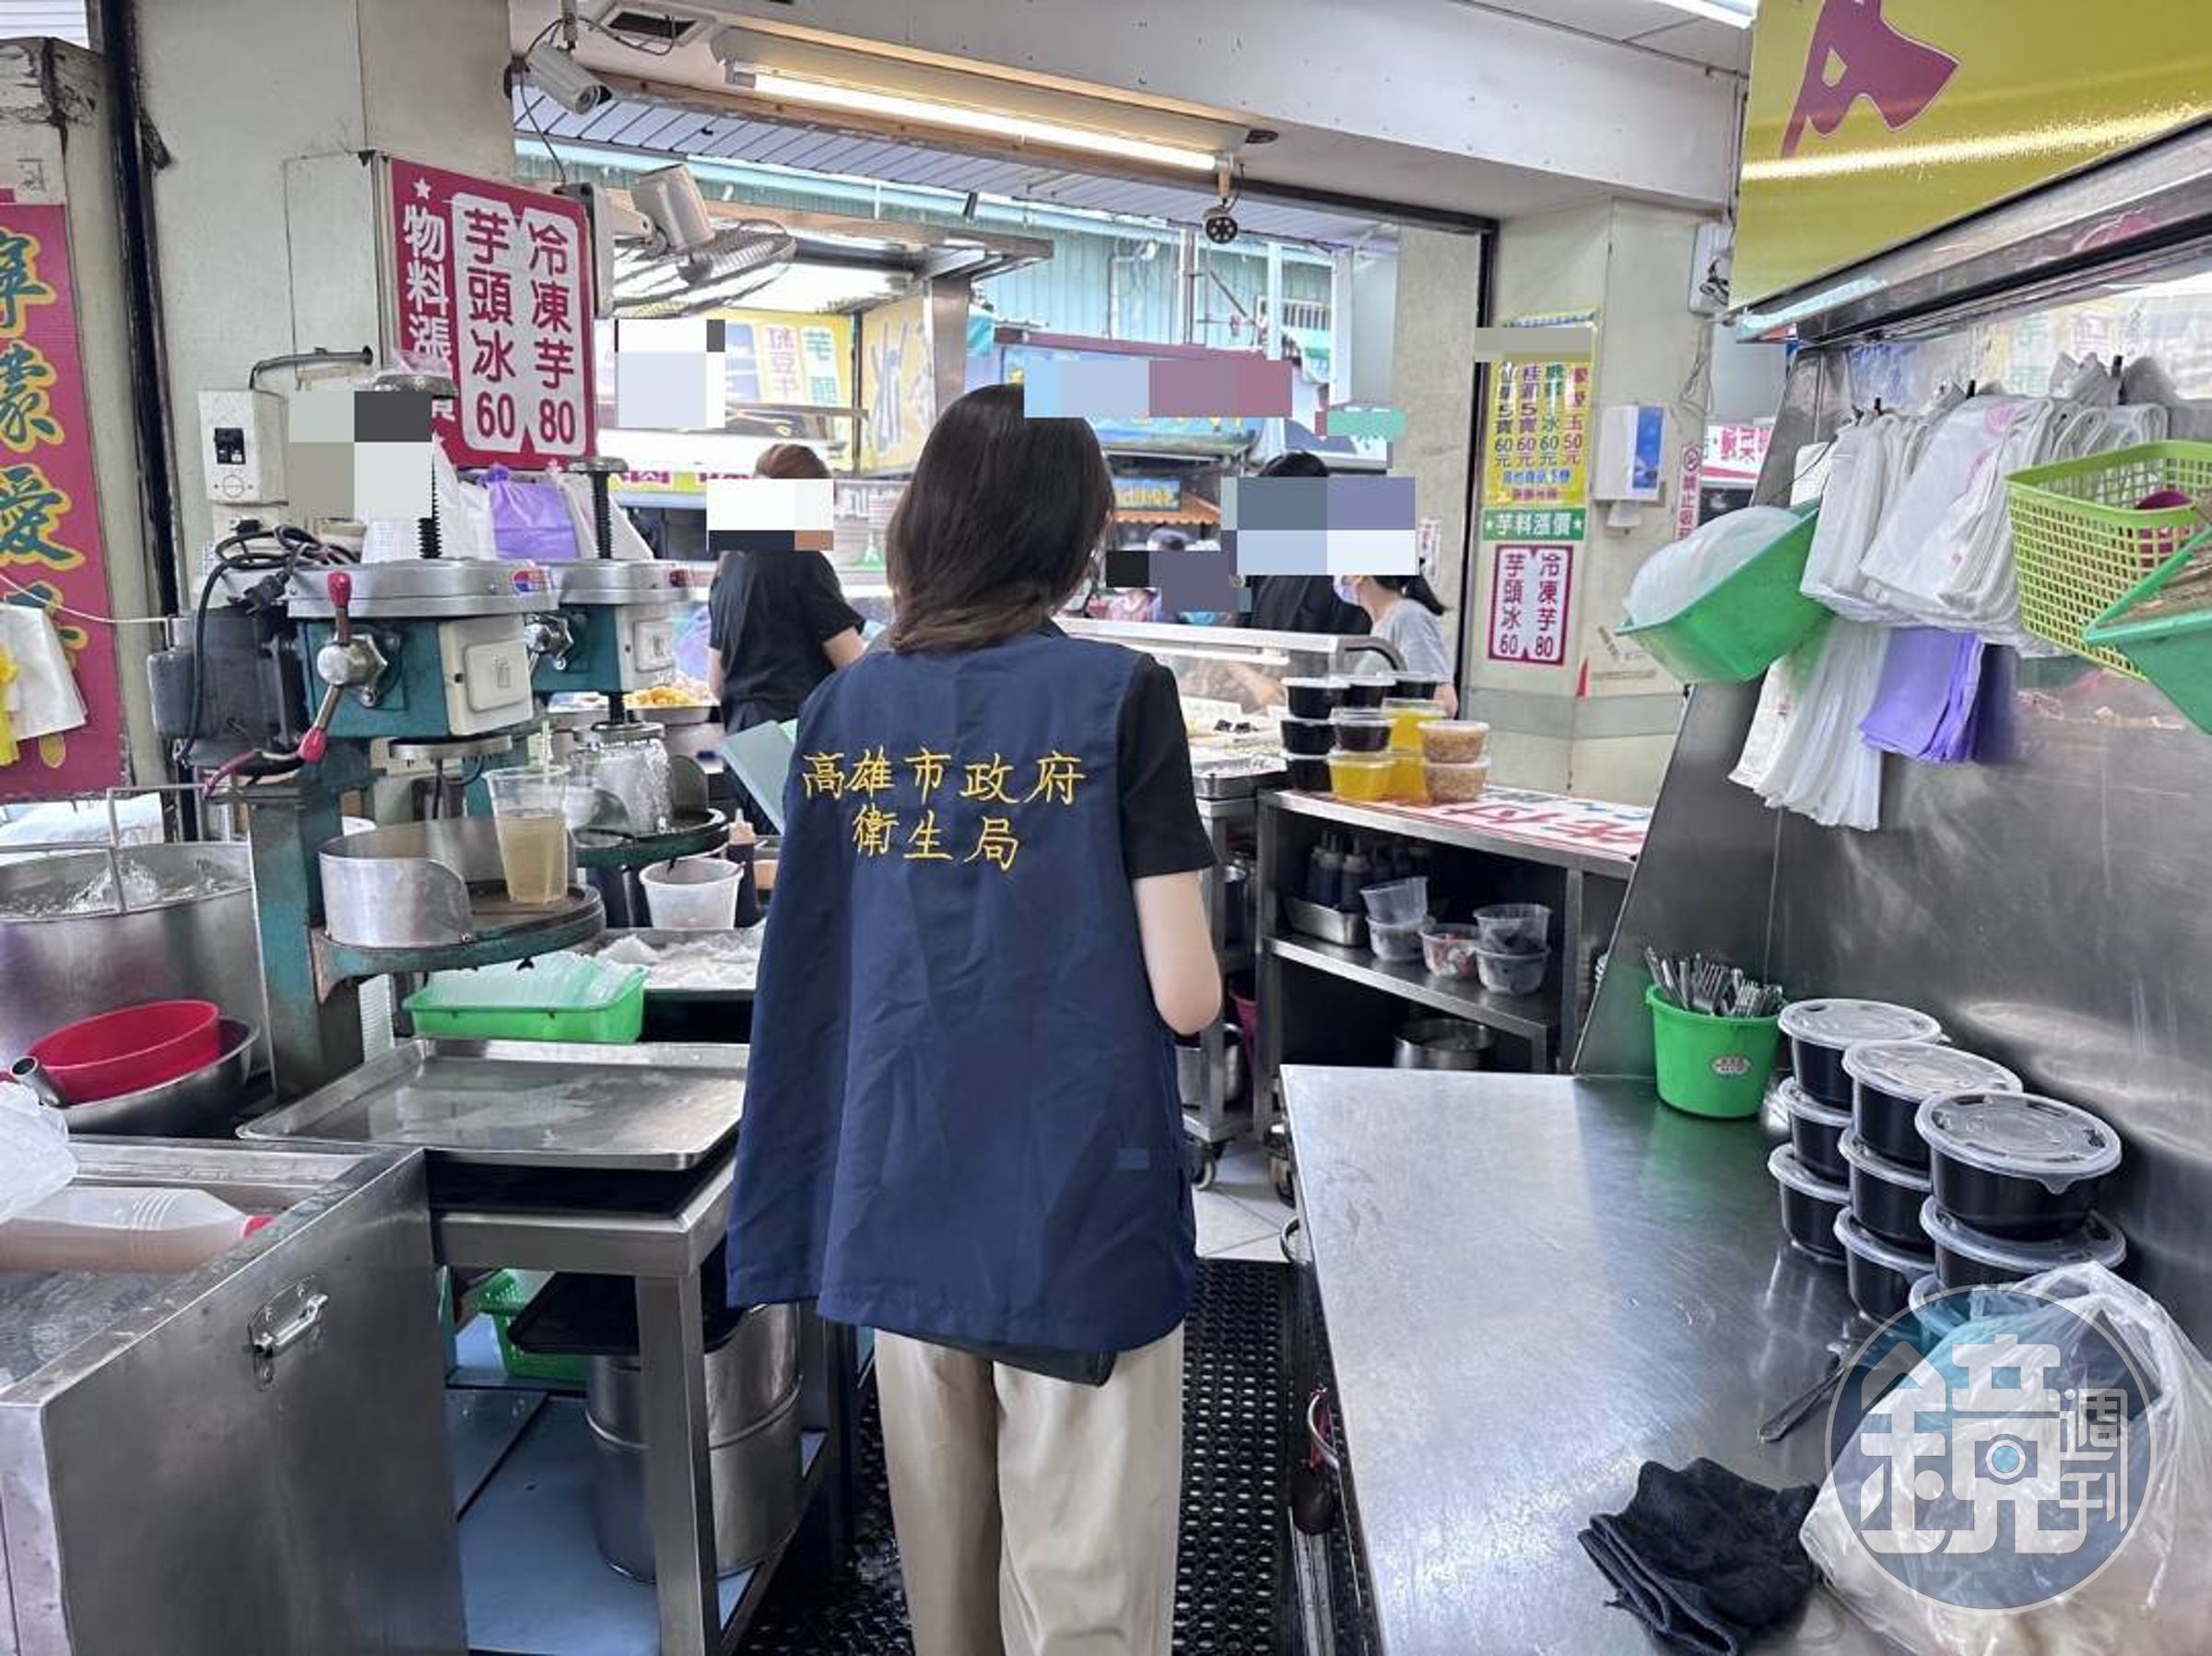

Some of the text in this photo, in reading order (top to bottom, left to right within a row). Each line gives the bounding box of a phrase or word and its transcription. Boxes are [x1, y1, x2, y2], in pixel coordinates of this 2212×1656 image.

[404, 204, 455, 422] 物料漲
[464, 207, 516, 440] 芋頭冰60
[528, 221, 576, 445] 冷凍芋80
[1500, 553, 1525, 655] 芋頭冰60
[1535, 552, 1561, 658] 冷凍芋80
[801, 744, 1086, 806] 高雄市政府
[851, 802, 1020, 872] 衛生局
